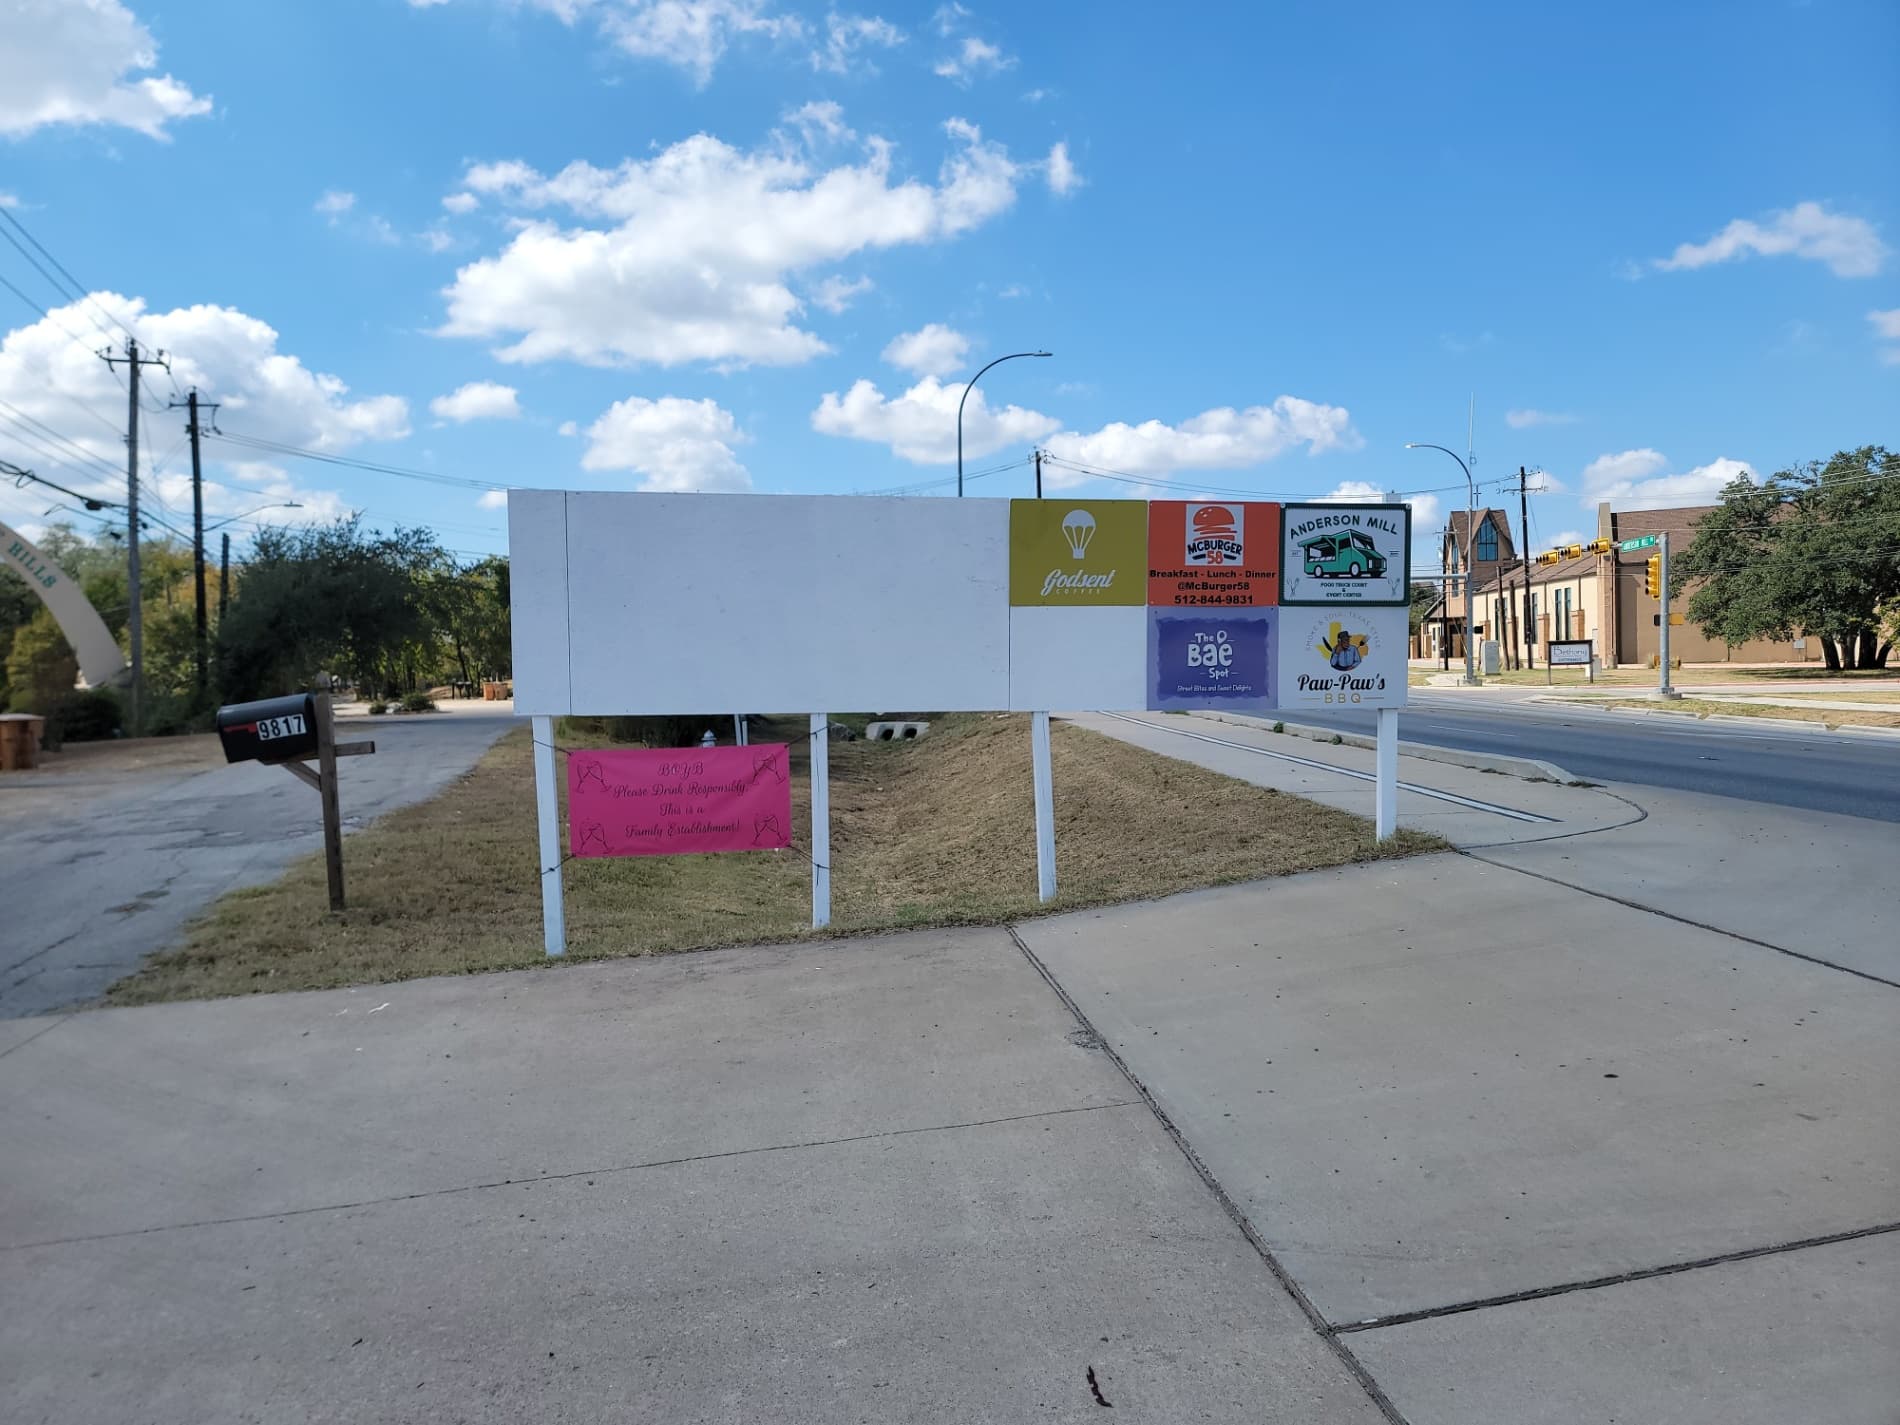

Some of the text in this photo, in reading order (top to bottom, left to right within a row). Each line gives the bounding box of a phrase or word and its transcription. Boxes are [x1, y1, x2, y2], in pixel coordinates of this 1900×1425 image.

[1290, 514, 1398, 540] ANDERSON MILL
[1187, 540, 1242, 555] MCBURGER
[8, 541, 57, 588] HILLS
[1206, 550, 1224, 565] 58
[1149, 570, 1198, 578] Breakfast
[1207, 570, 1237, 578] Lunch
[1245, 570, 1276, 578] Dinner
[1040, 569, 1116, 596] Godsent
[1178, 581, 1250, 592] @McBurger58
[1174, 594, 1254, 605] 512-844-9831
[1195, 632, 1215, 643] The
[1187, 643, 1233, 667] Bae
[1208, 667, 1230, 680] Spot
[1297, 673, 1386, 691] Paw-Paw's
[1324, 693, 1361, 704] BBQ
[259, 715, 302, 739] 9817
[613, 784, 648, 799] Please
[652, 783, 684, 796] Drink
[659, 802, 704, 816] This is a
[625, 818, 740, 838] Family Establishment!
